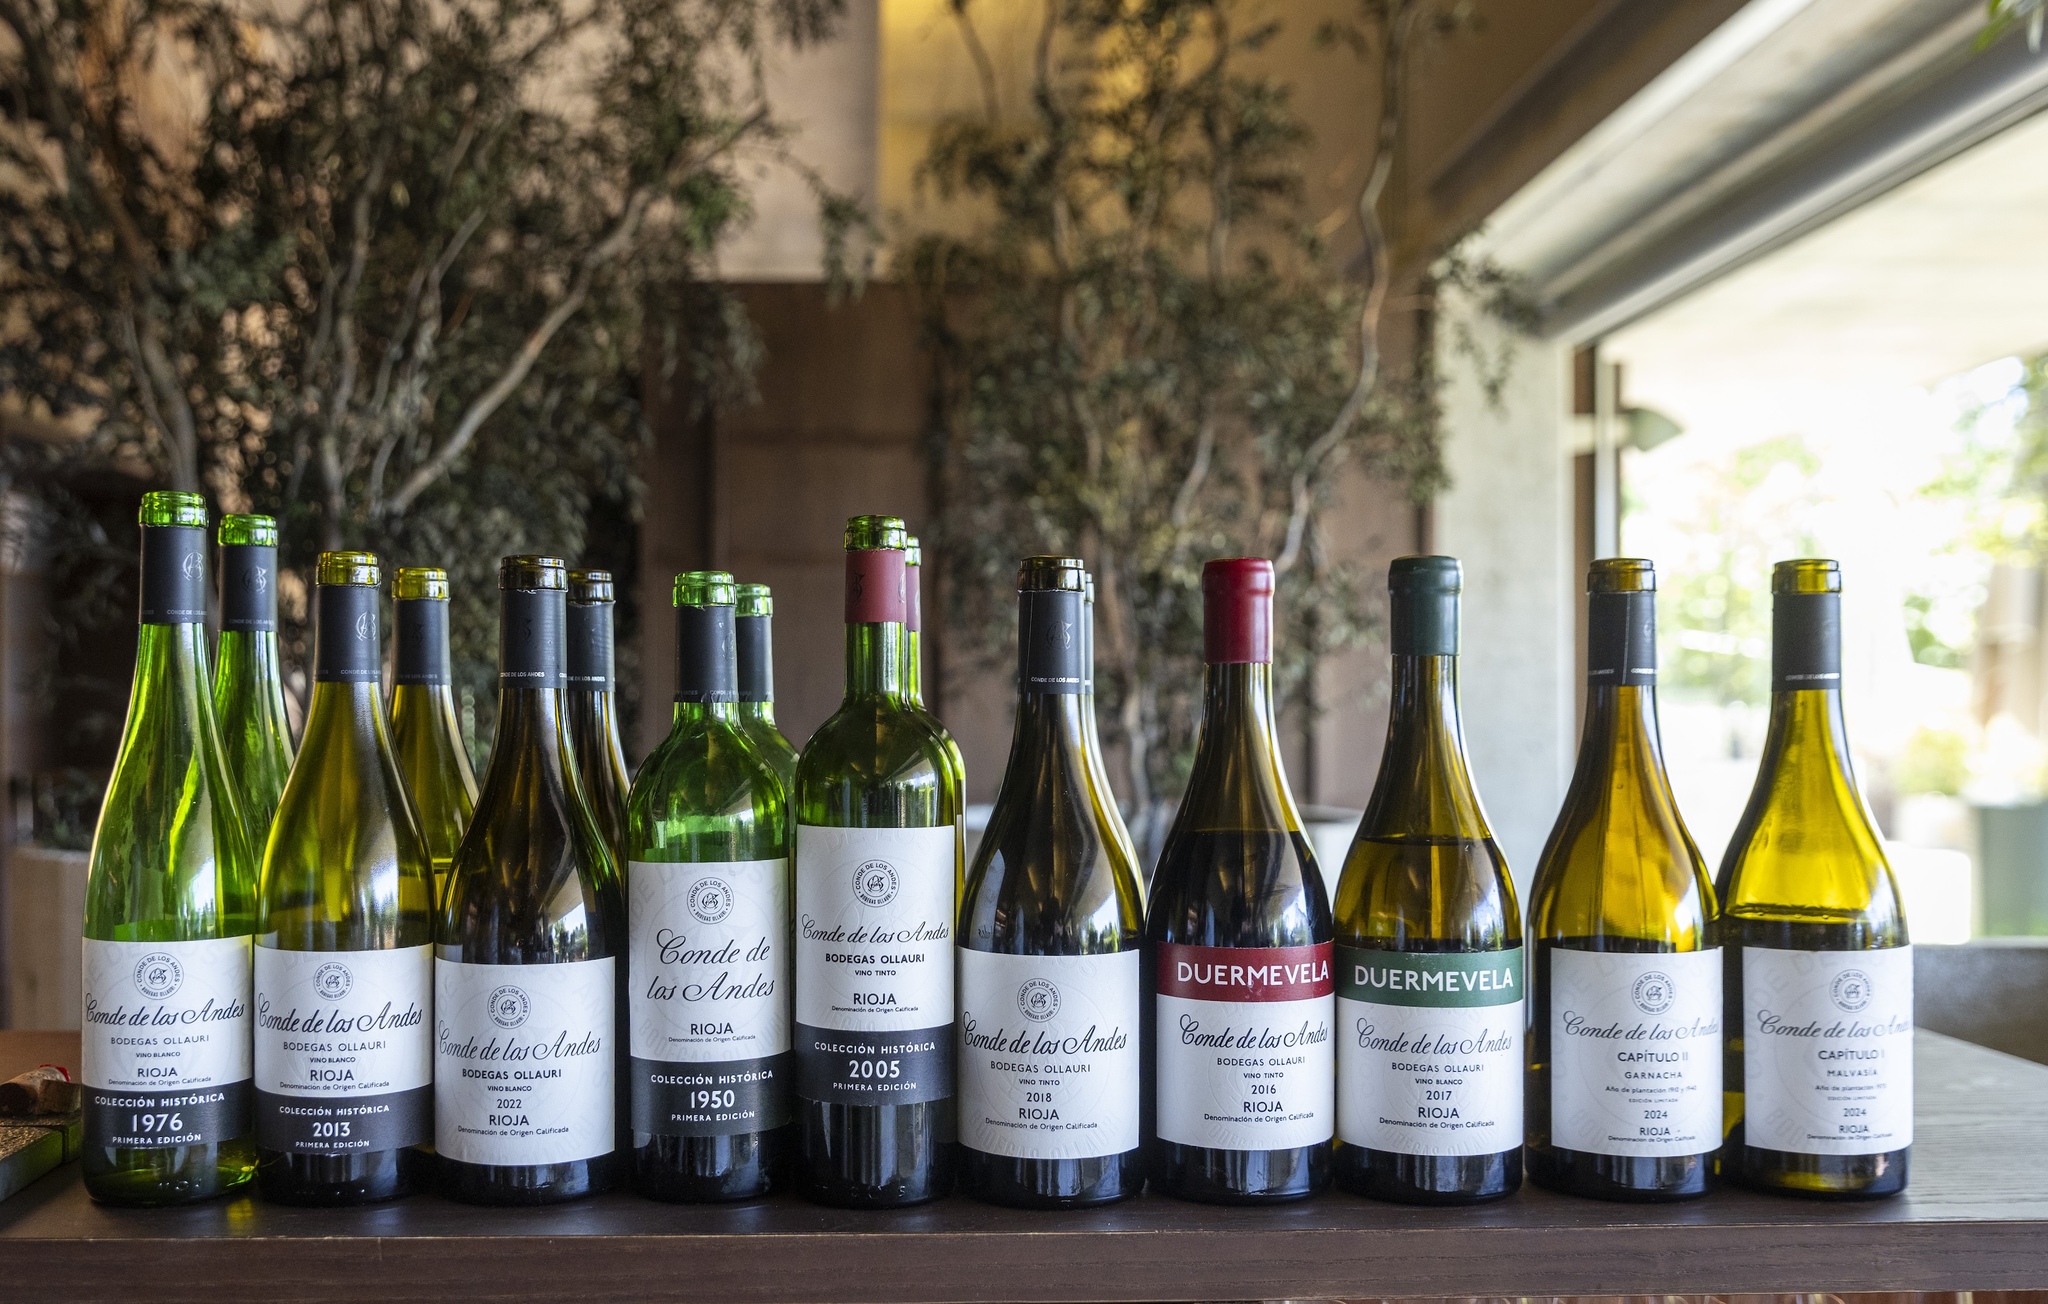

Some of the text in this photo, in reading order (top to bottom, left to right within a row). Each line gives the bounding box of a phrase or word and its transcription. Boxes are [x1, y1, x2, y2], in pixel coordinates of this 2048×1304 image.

[855, 868, 866, 890] CONDE
[875, 863, 888, 871] LOS
[887, 869, 897, 890] ANDES
[802, 914, 949, 943] Conde de los Andes
[656, 929, 770, 964] Conde de
[826, 953, 925, 964] BODEGAS OLLAURI
[1177, 960, 1329, 986] DUERMEVELA
[1355, 965, 1513, 992] DUERMEVELA
[647, 971, 775, 1001] los Andes
[853, 993, 896, 1005] RIOJA
[86, 992, 244, 1025] Conde de los Andes
[258, 993, 422, 1033] Conde de los Andes
[690, 1023, 734, 1035] RIOJA
[1563, 1010, 1674, 1040] Conde de los
[963, 1011, 1127, 1054] Conde de los Andes
[1180, 1014, 1328, 1049] Conde de los Andes
[1356, 1017, 1512, 1055] Conde de los Andes
[111, 1035, 209, 1045] BODEGAS OLLAURI
[284, 1041, 386, 1051] BODEGAS OLLAURI
[439, 1019, 601, 1061] Conde de los Andes
[814, 1041, 936, 1054] COLECCIÓN HISTÓRICA
[1217, 1056, 1306, 1067] BODEGAS OLLAURI
[1617, 1049, 1688, 1063] CAPÍTULO II
[138, 1068, 178, 1077] RIOJA
[849, 1060, 901, 1078] 2005
[991, 1061, 1091, 1074] BODEGAS OLLAURI
[1392, 1062, 1484, 1073] BODEGAS OLLAURI
[182, 1076, 211, 1084] Calificada
[310, 1070, 354, 1081] RIOJA
[462, 1069, 562, 1079] BODEGAS OLLAURI
[651, 1070, 773, 1085] COLECCIÓN HISTÓRICA
[1625, 1071, 1682, 1079] GARNACHA
[833, 1081, 917, 1091] PRIMERA EDICIÓN
[1251, 1084, 1277, 1095] 2016
[95, 1093, 225, 1107] COLECCIÓN HISTÓRICA
[690, 1090, 735, 1109] 1950
[1026, 1092, 1052, 1102] 2018
[1426, 1090, 1452, 1101] 2017
[497, 1099, 522, 1109] 2022
[1243, 1101, 1283, 1112] RIOJA
[279, 1105, 389, 1116] COLECCIÓN HISTÓRICA
[672, 1111, 755, 1122] PRIMERA EDICIÓN
[1019, 1108, 1059, 1120] RIOJA
[1418, 1107, 1460, 1119] RIOJA
[1644, 1110, 1668, 1119] 2024
[132, 1113, 183, 1132] 1976
[489, 1115, 529, 1126] RIOJA
[1204, 1113, 1252, 1123] Denominación
[1265, 1115, 1287, 1124] Origen
[1288, 1112, 1314, 1121] Calificada
[1379, 1117, 1427, 1128] Denominación
[1440, 1122, 1464, 1130] Origen
[313, 1122, 351, 1137] 2013
[985, 1118, 1027, 1129] Denominación
[1040, 1123, 1063, 1131] Origen
[1066, 1122, 1098, 1130] Calificada
[458, 1125, 497, 1135] Denominación
[510, 1129, 534, 1137] Origen
[536, 1126, 569, 1135] Calificada
[1639, 1127, 1670, 1136] RIOJA
[112, 1133, 201, 1144] PRIMERA EDICIÓN
[334, 1140, 370, 1148] EDICIÓN
